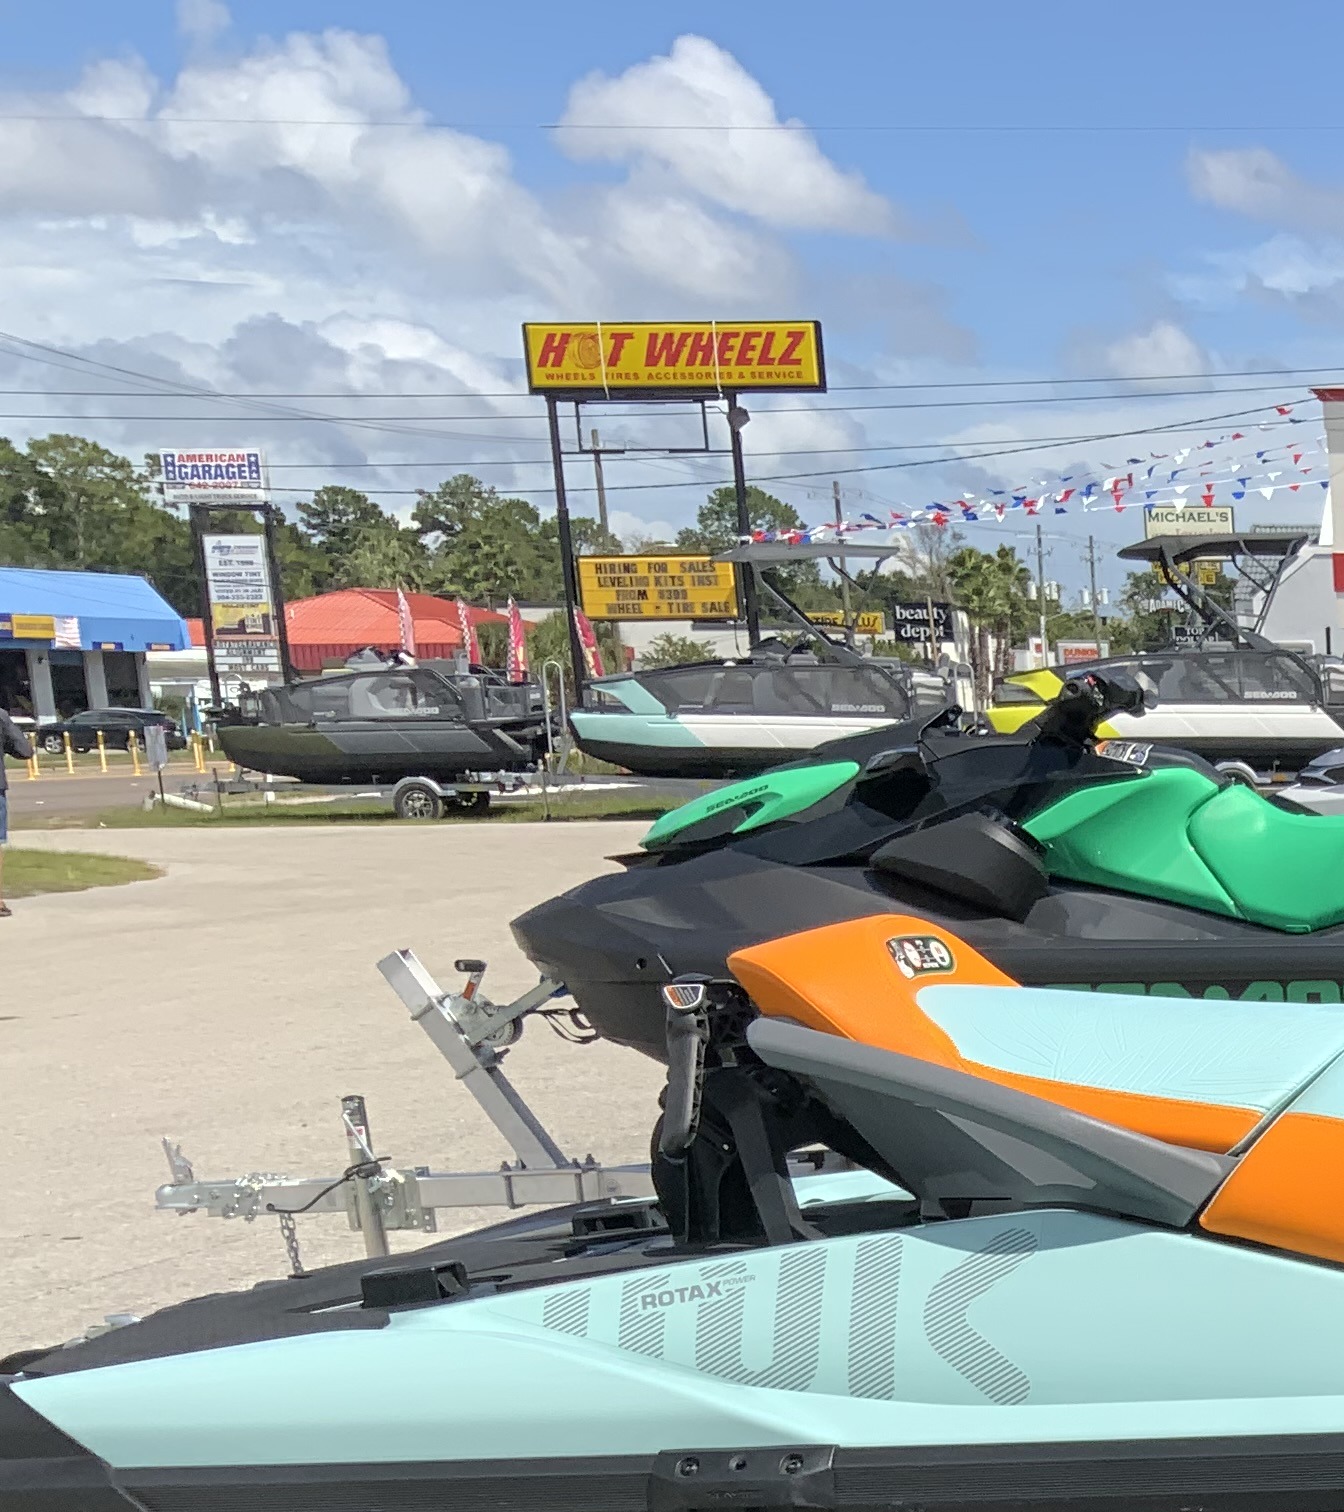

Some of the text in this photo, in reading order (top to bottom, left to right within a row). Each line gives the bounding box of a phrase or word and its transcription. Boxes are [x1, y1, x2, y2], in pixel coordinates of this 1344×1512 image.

[644, 331, 806, 368] WHEELZ
[545, 373, 596, 381] WHEELS
[604, 373, 640, 381] TIRES
[750, 371, 804, 380] SERVICE
[177, 453, 246, 463] AMERICAN
[177, 463, 248, 480] GARAGE
[1148, 511, 1229, 523] MICHAEL'S
[595, 561, 716, 575] HIRING FOR SALES
[598, 577, 649, 588] LEVELING
[654, 576, 685, 587] KITS
[667, 602, 695, 613] TIRE
[702, 602, 730, 613] SALE
[895, 604, 948, 624] beauty
[640, 1274, 757, 1310] ROTAX POWER
